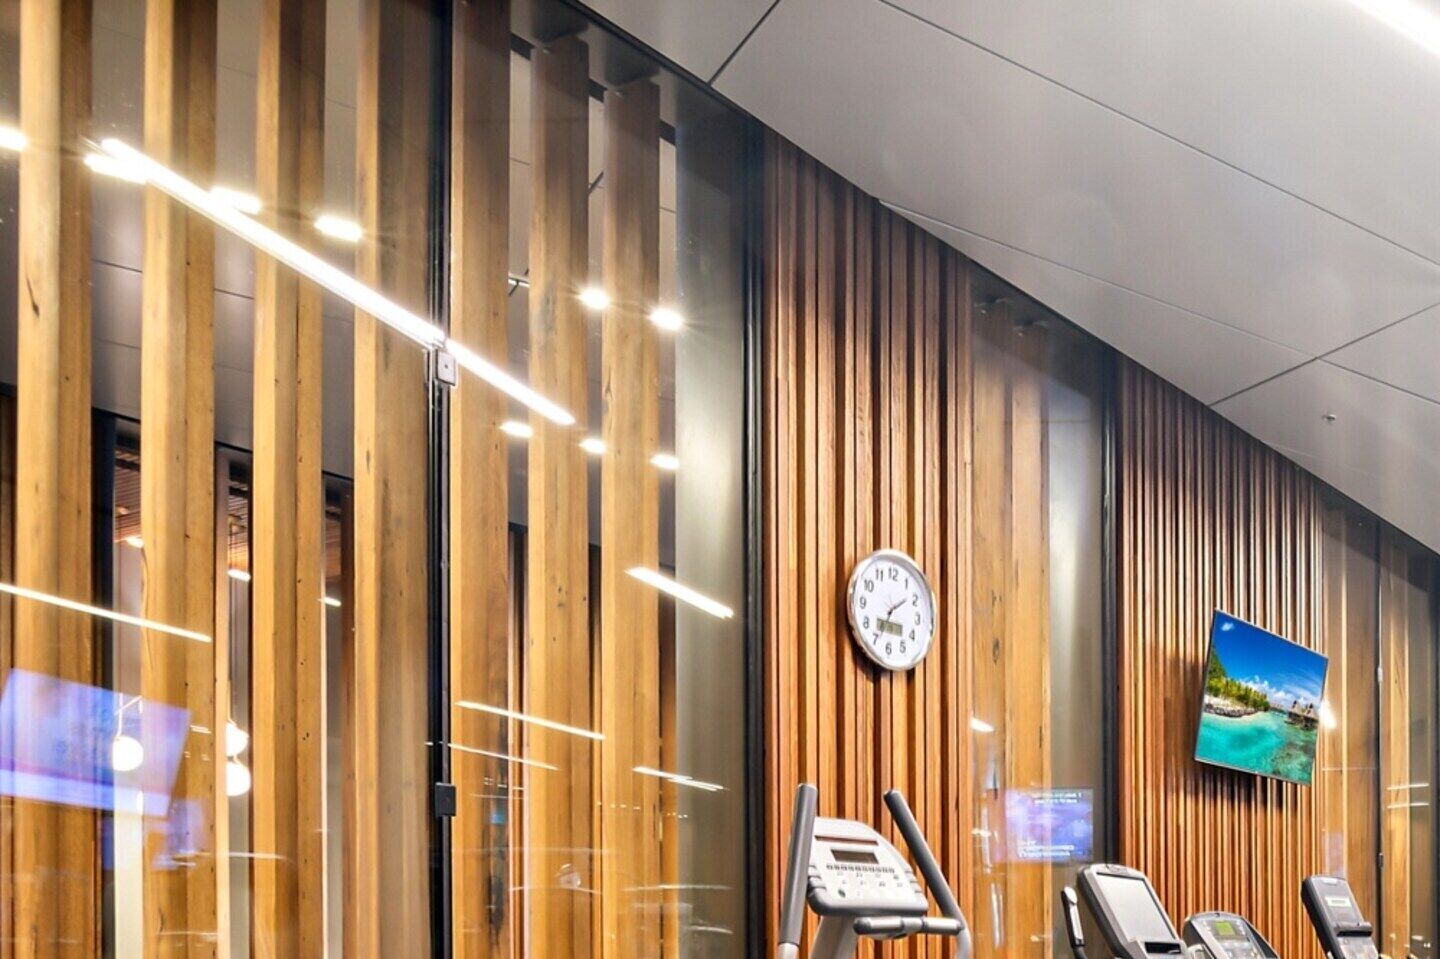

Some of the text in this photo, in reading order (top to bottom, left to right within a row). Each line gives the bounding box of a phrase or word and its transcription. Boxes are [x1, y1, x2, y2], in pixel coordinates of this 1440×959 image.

[876, 568, 884, 582] 11
[889, 566, 899, 582] 12
[864, 579, 874, 593] 10
[860, 595, 867, 609] 9
[912, 592, 919, 607] 2
[863, 616, 870, 629] 8
[915, 612, 920, 626] 3
[872, 631, 879, 645] 7
[909, 628, 916, 641] 4
[885, 641, 892, 655] 6
[899, 641, 907, 654] 5
